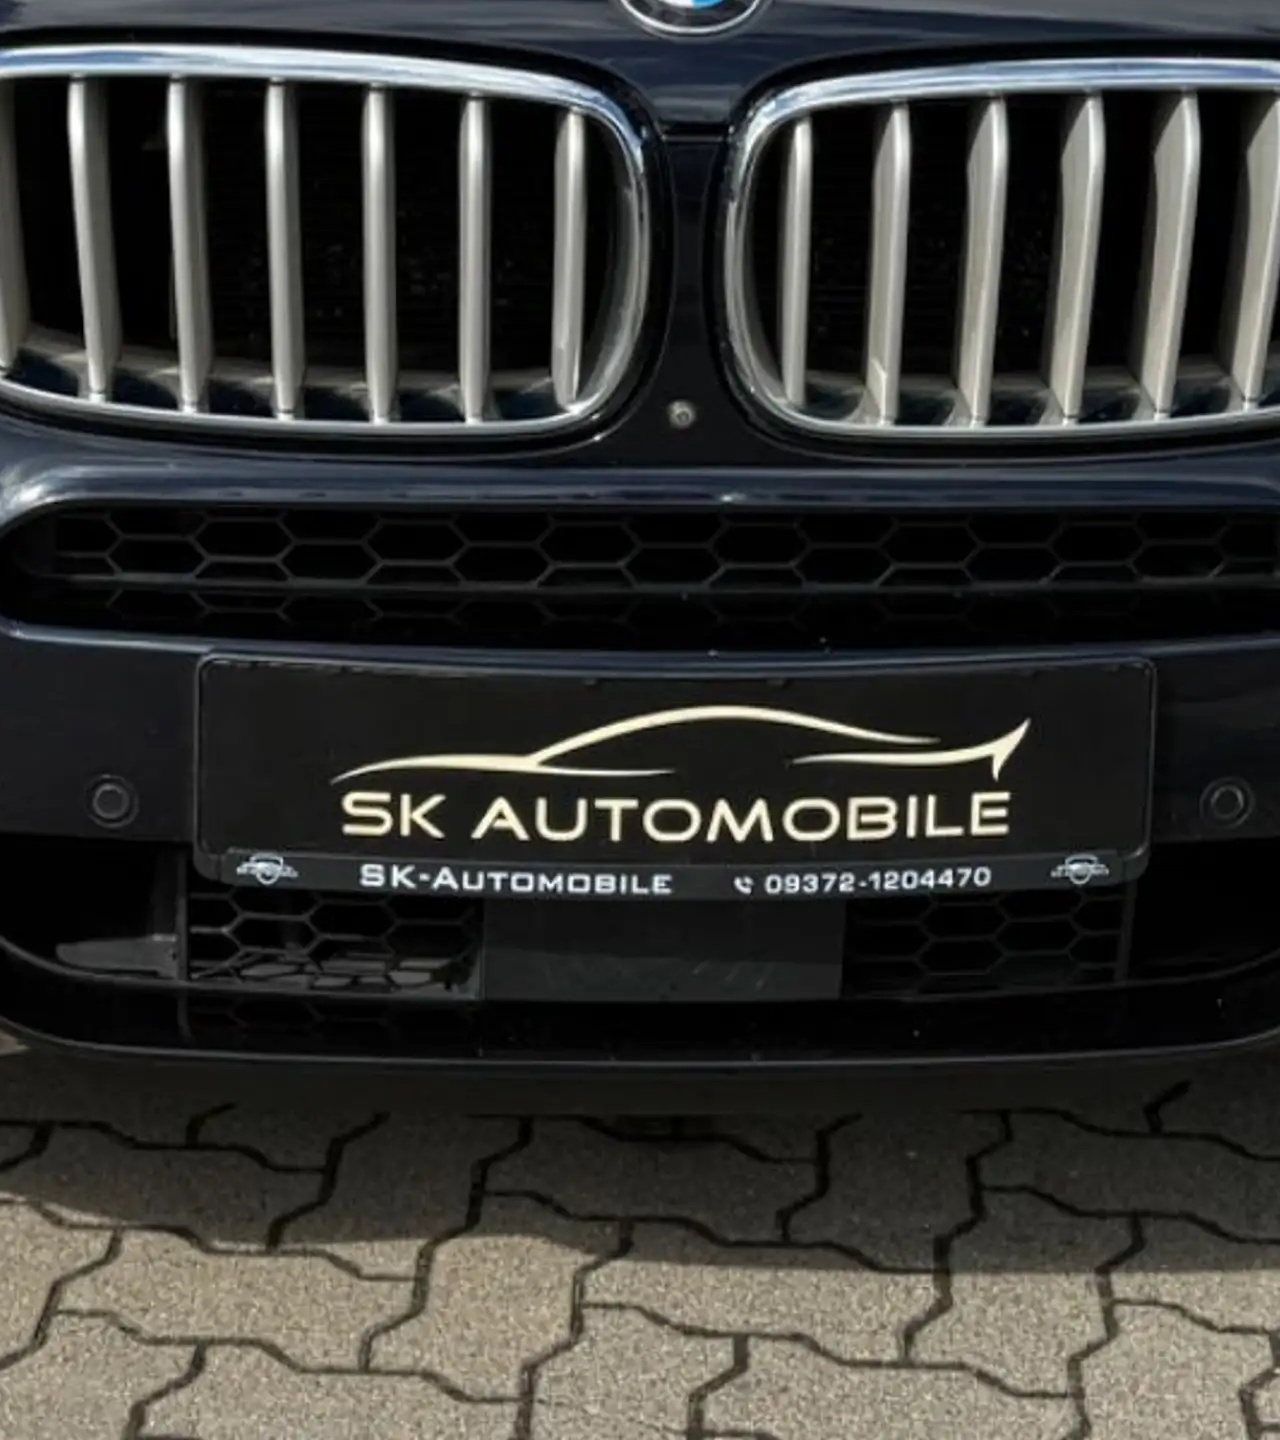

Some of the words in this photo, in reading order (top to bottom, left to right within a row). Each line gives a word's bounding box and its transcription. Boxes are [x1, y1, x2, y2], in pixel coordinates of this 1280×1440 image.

[341, 790, 448, 839] SK
[470, 791, 1012, 844] AUTOMOBILE
[359, 862, 674, 896] SK-AUTOMOBILE
[763, 865, 993, 895] 09372-1204470
